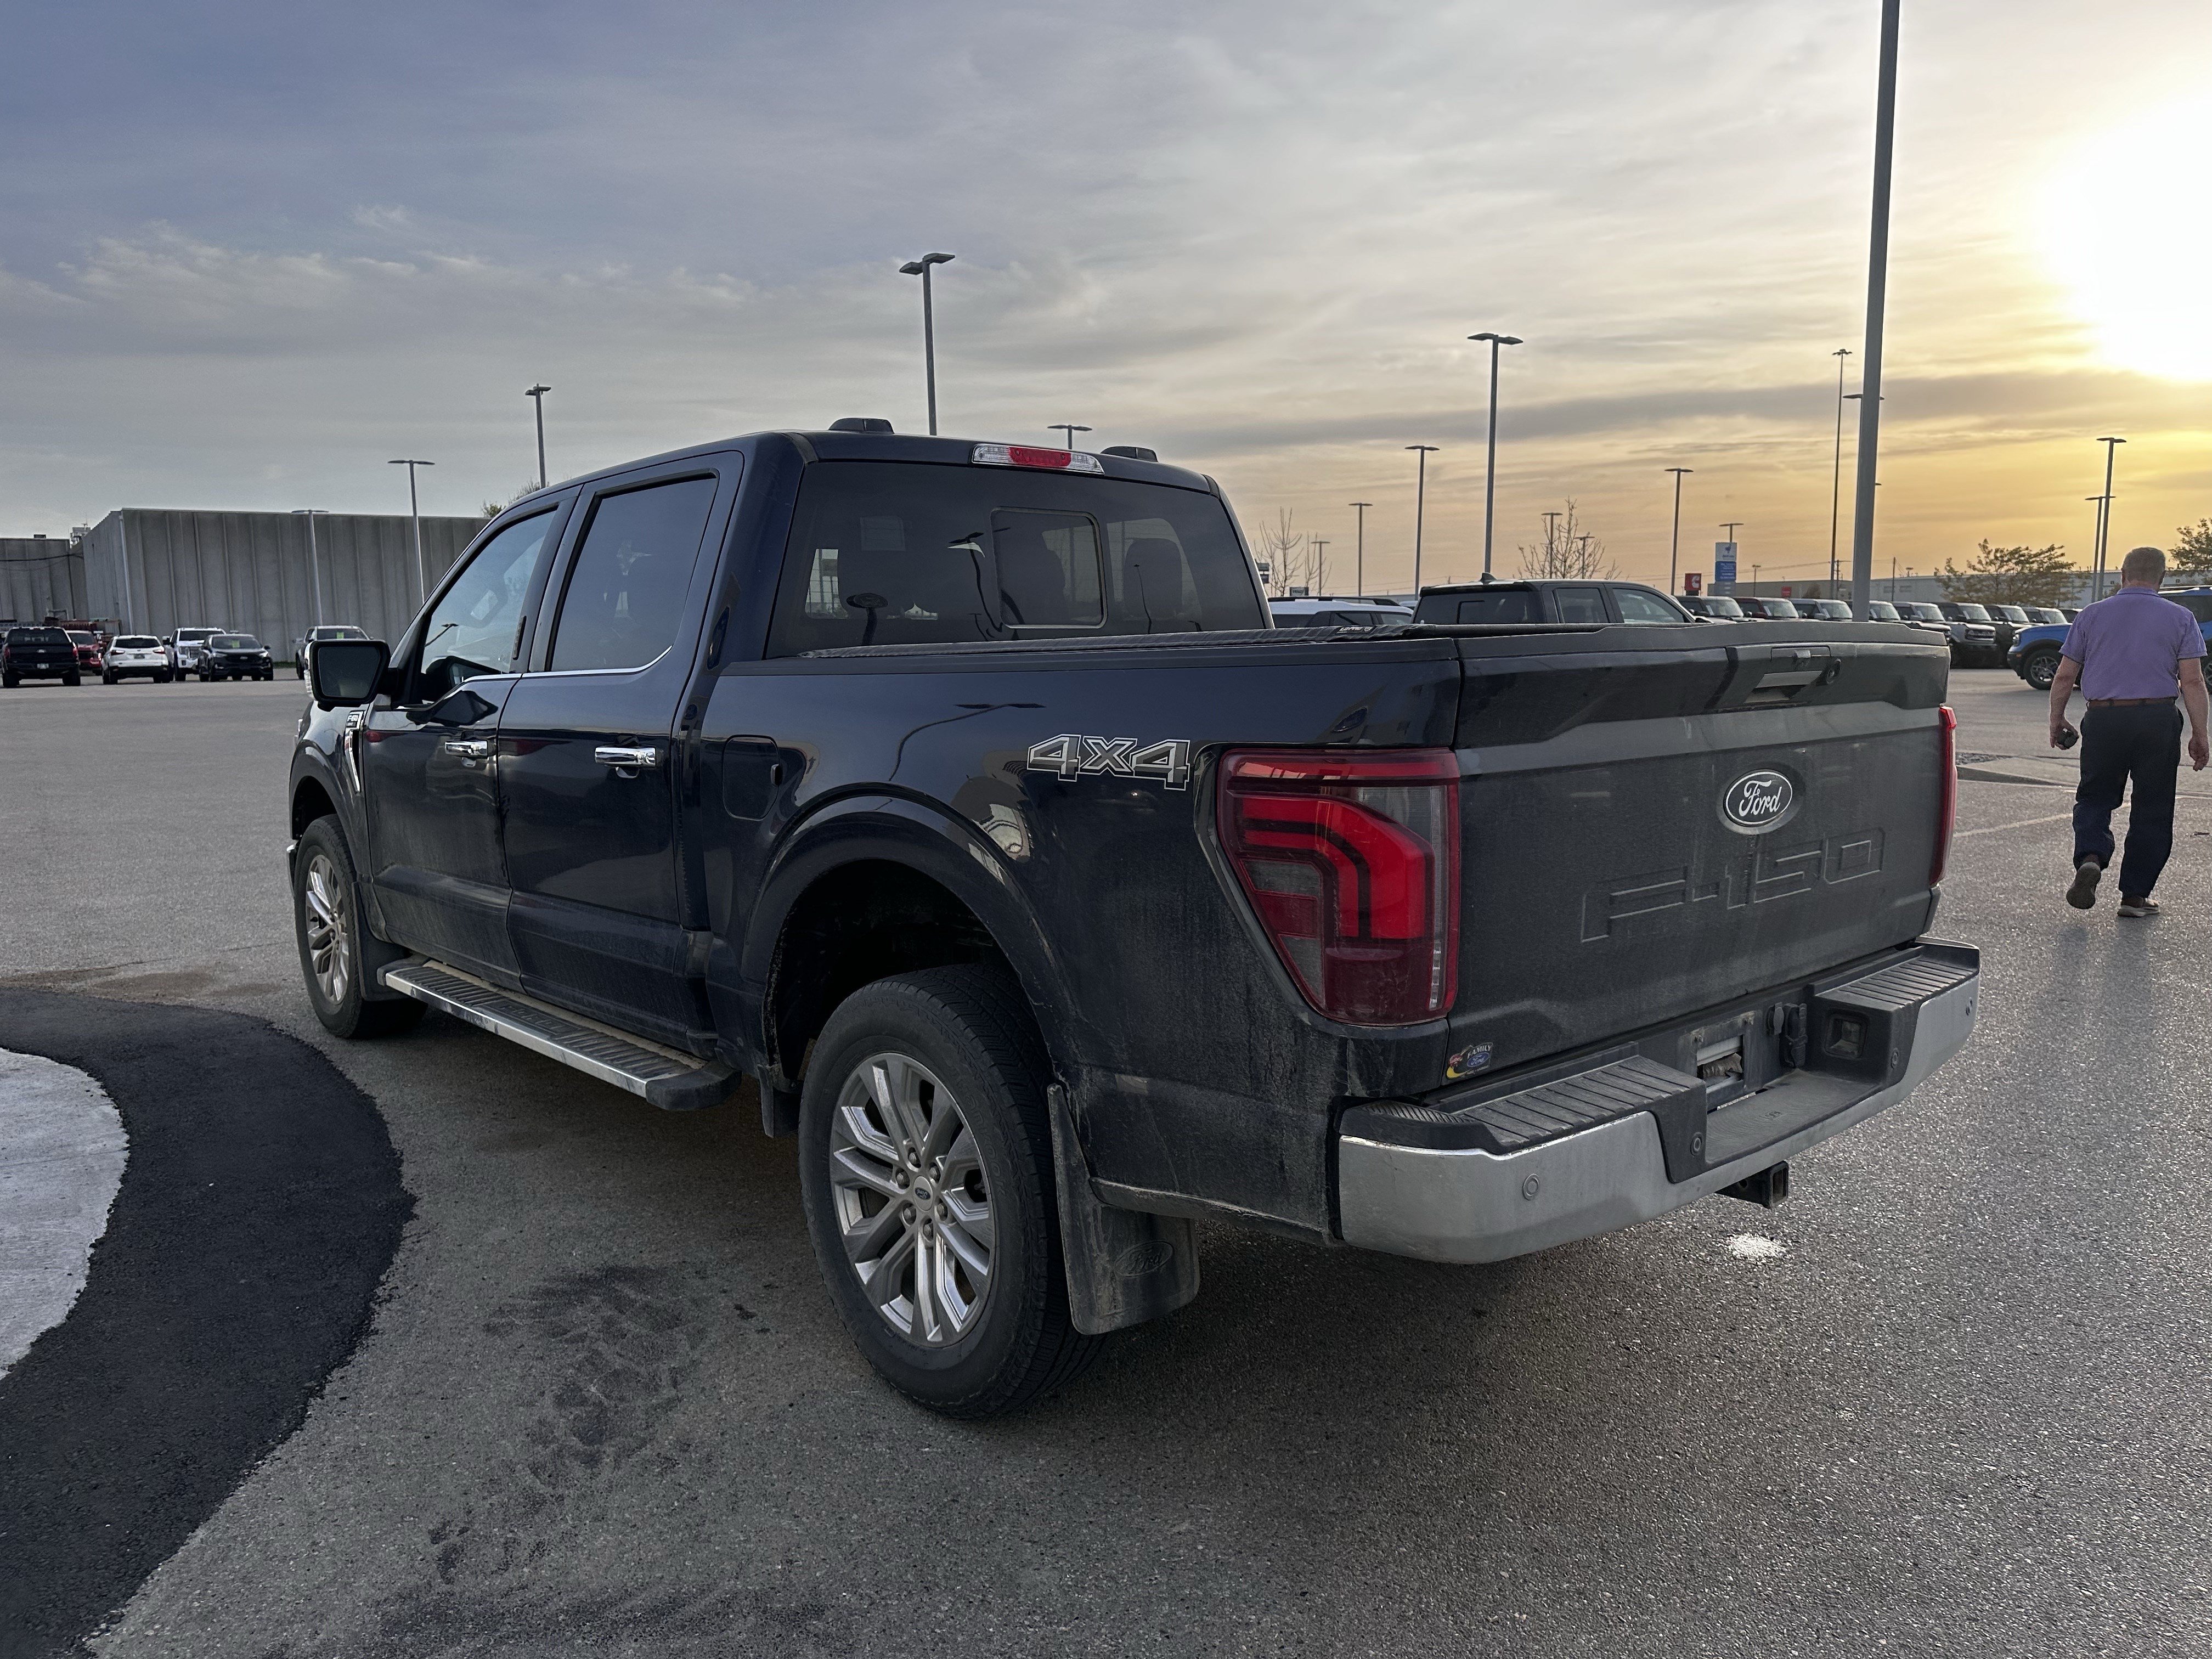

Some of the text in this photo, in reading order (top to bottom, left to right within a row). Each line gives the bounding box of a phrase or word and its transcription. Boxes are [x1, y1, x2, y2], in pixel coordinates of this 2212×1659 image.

[1739, 780, 1782, 816] Ford
[1467, 1044, 1491, 1059] FAMILY
[917, 1189, 928, 1199] Ford
[1126, 1249, 1163, 1271] Ford
